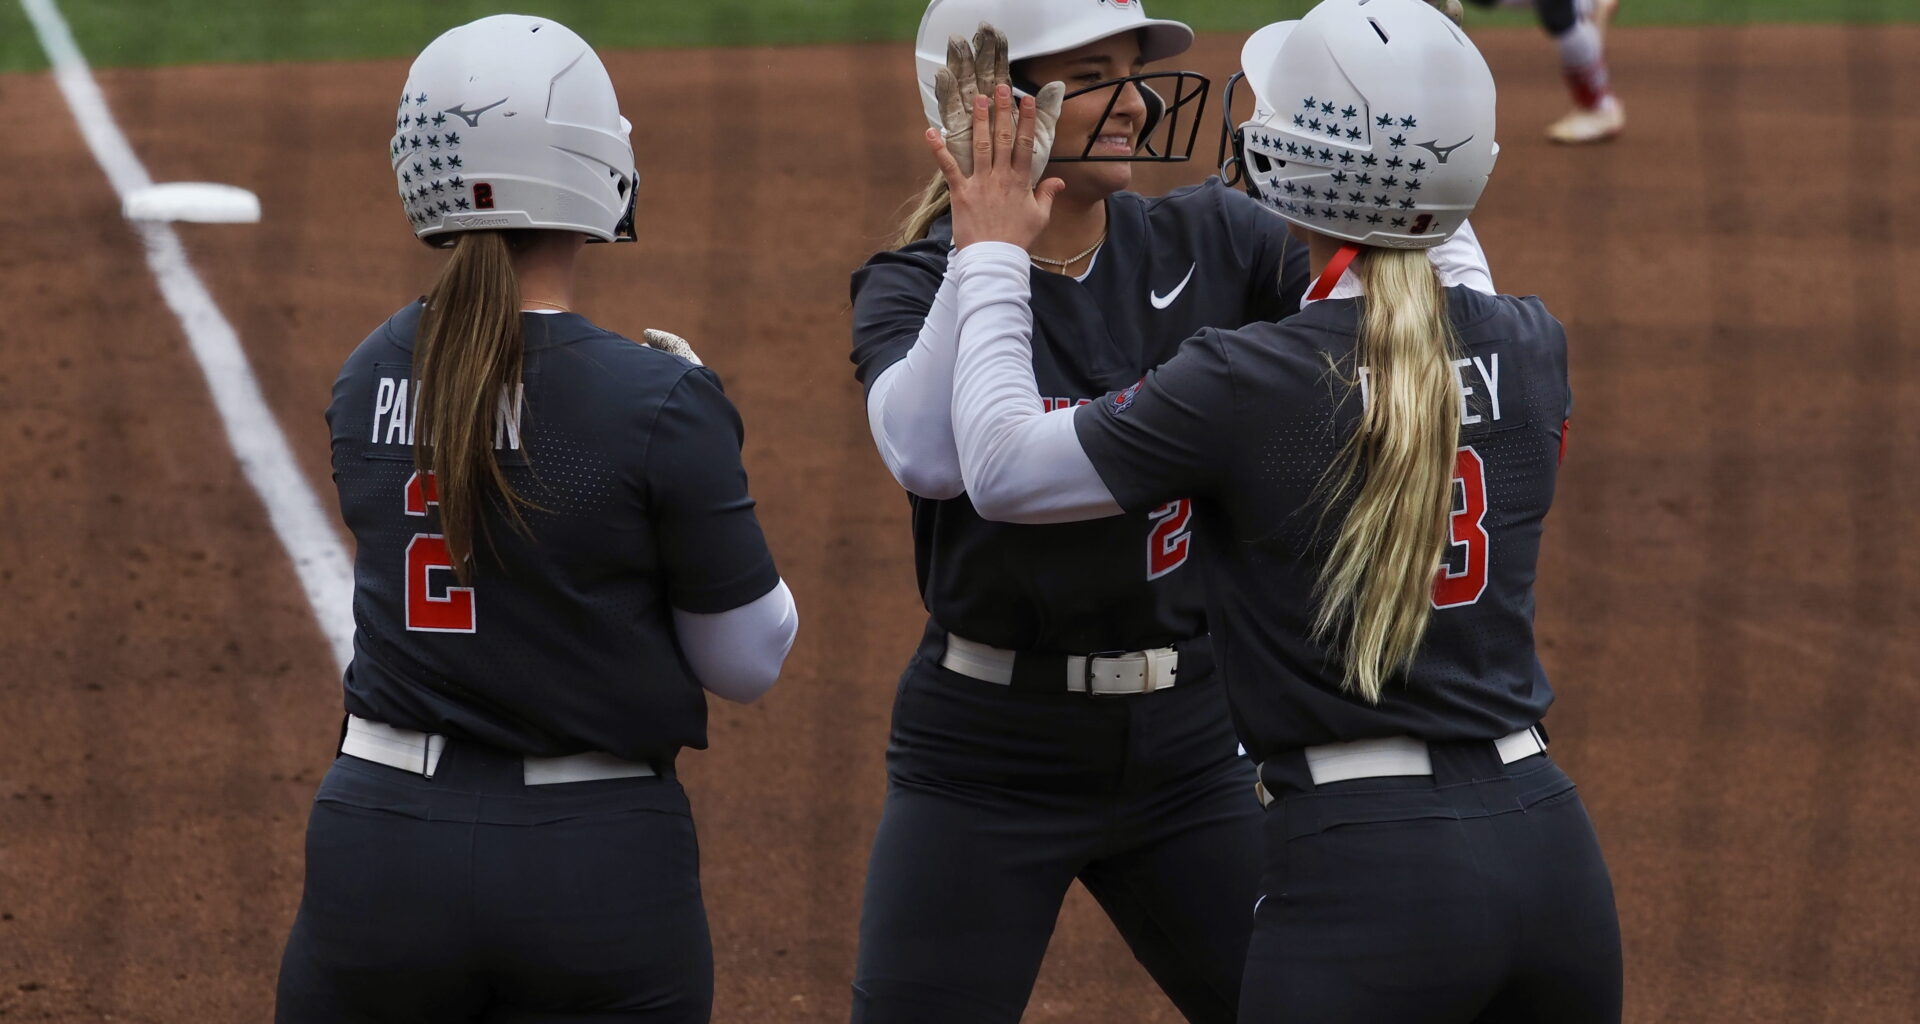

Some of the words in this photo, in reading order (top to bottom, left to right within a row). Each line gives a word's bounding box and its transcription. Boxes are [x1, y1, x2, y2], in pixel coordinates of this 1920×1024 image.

[472, 182, 495, 210] 2
[1409, 213, 1434, 234] 3
[405, 469, 476, 633] 2
[1146, 498, 1192, 582] 2
[1430, 445, 1489, 610] 3
